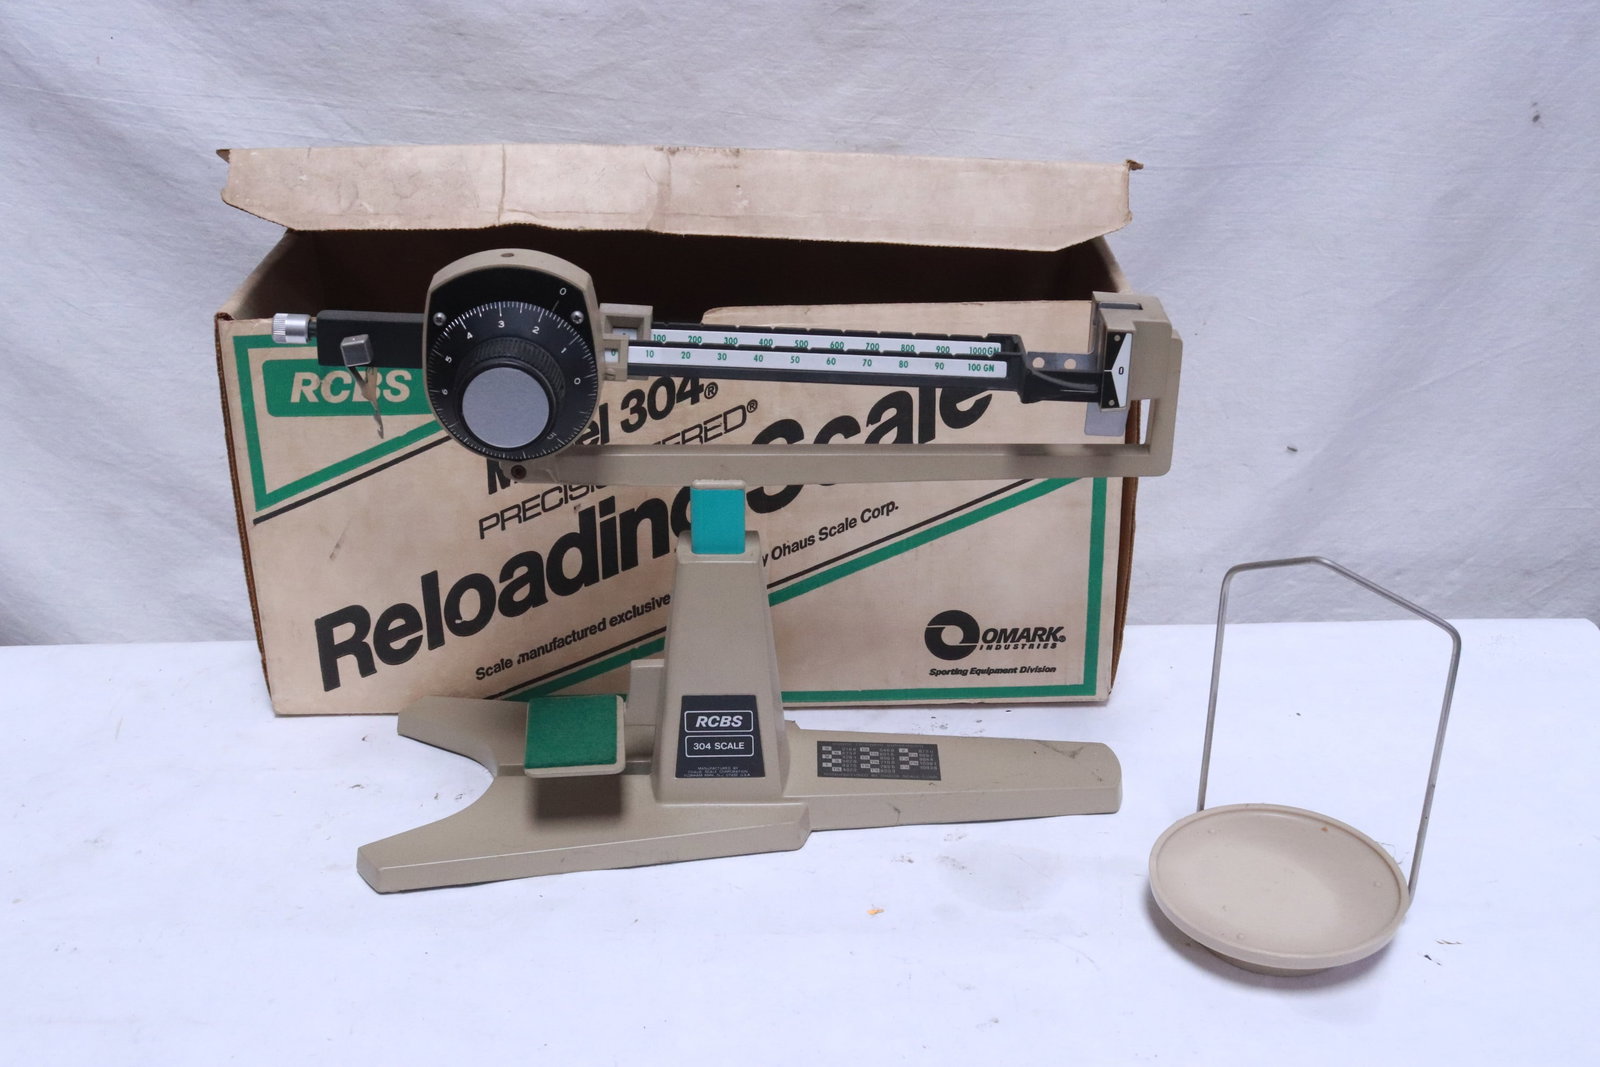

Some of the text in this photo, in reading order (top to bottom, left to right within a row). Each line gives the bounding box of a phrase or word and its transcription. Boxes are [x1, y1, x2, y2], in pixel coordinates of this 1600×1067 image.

[559, 287, 567, 296] 0
[466, 332, 474, 340] 4
[498, 320, 505, 328] 3
[532, 326, 540, 335] 2
[653, 334, 667, 342] 100
[688, 335, 703, 344] 200
[723, 336, 739, 345] 300
[758, 338, 774, 347] 400
[794, 339, 809, 348] 500
[830, 341, 845, 350] 600
[865, 342, 880, 351] 700
[900, 344, 915, 352] 800
[936, 345, 951, 354] 900
[444, 355, 453, 364] 5
[645, 350, 655, 358] 10
[681, 351, 691, 359] 20
[717, 352, 727, 361] 30
[753, 354, 764, 363] 40
[790, 355, 800, 364] 50
[826, 357, 837, 366] 60
[862, 358, 873, 367] 70
[899, 360, 909, 369] 80
[934, 361, 945, 370] 90
[967, 363, 981, 372] 100
[1118, 366, 1124, 375] 0
[573, 377, 582, 385] 0
[475, 657, 514, 681] Scale
[517, 617, 607, 665] manufactured
[771, 534, 816, 561] Ohaus
[818, 516, 857, 542] Scale
[860, 500, 899, 524] Corp.
[979, 642, 1058, 651] INDUSTRIES
[929, 665, 1057, 677] Sporting Equipment Division
[695, 715, 744, 728] RCBS
[693, 741, 745, 750] 304 SCALE
